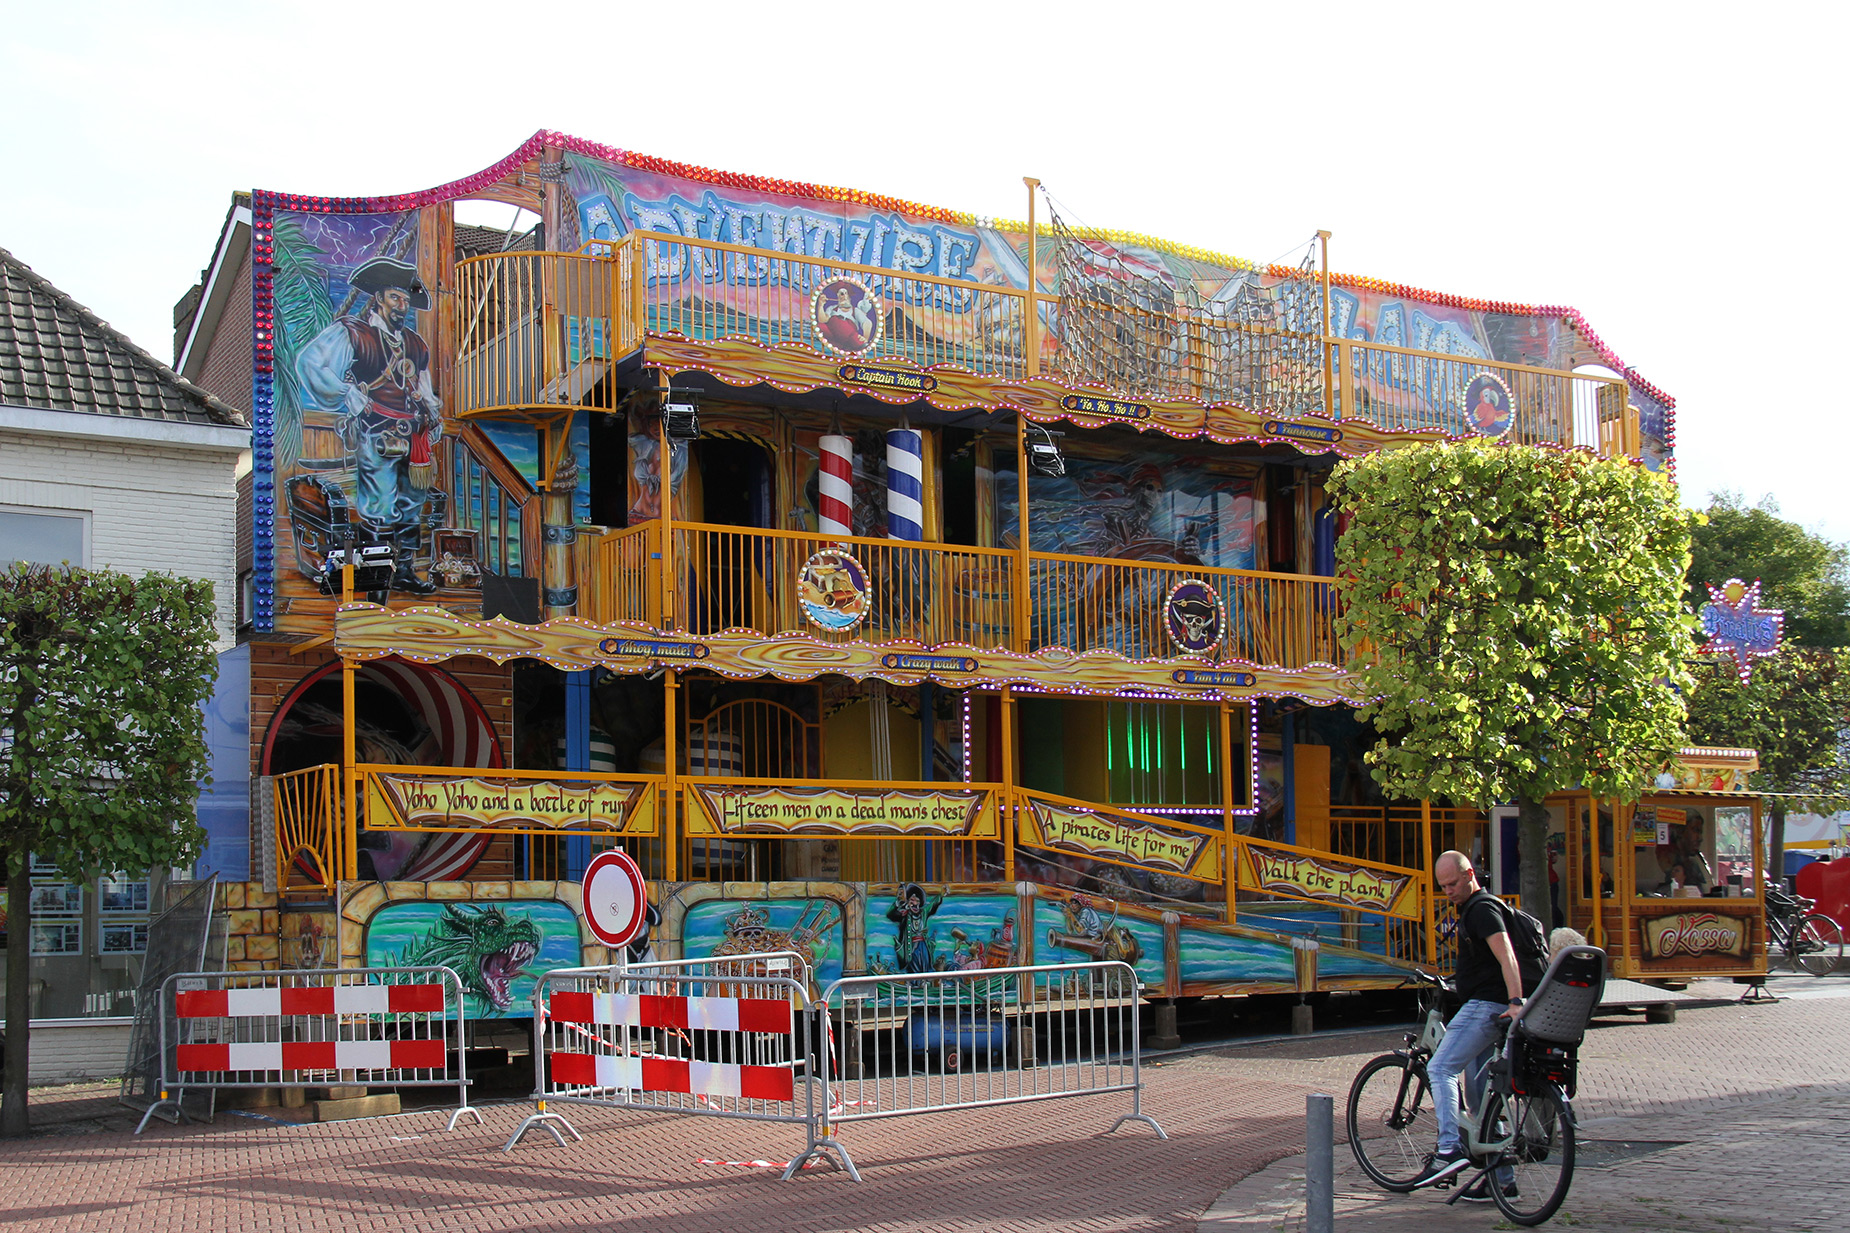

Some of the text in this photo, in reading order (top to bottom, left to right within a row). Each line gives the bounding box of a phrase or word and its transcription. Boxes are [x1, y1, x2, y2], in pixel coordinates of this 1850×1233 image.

[857, 368, 921, 388] Captain Hook
[1282, 424, 1327, 440] Funhouse
[1703, 605, 1774, 646] Pirates
[620, 641, 693, 659] Ahoy, mate!
[901, 655, 961, 673] Crazy walk
[1193, 671, 1212, 684] Fun
[1214, 672, 1221, 684] 4
[401, 782, 629, 826] Yoho Yoho and a bottle of rum
[720, 791, 966, 828] Fifteen men on a dead man's chest
[1043, 808, 1056, 831] A
[1062, 819, 1111, 843] pirates
[1115, 822, 1140, 855] life
[1143, 829, 1166, 859] for
[1253, 853, 1300, 882] Walk
[1306, 865, 1334, 888] the
[1659, 913, 1737, 958] Kassa
